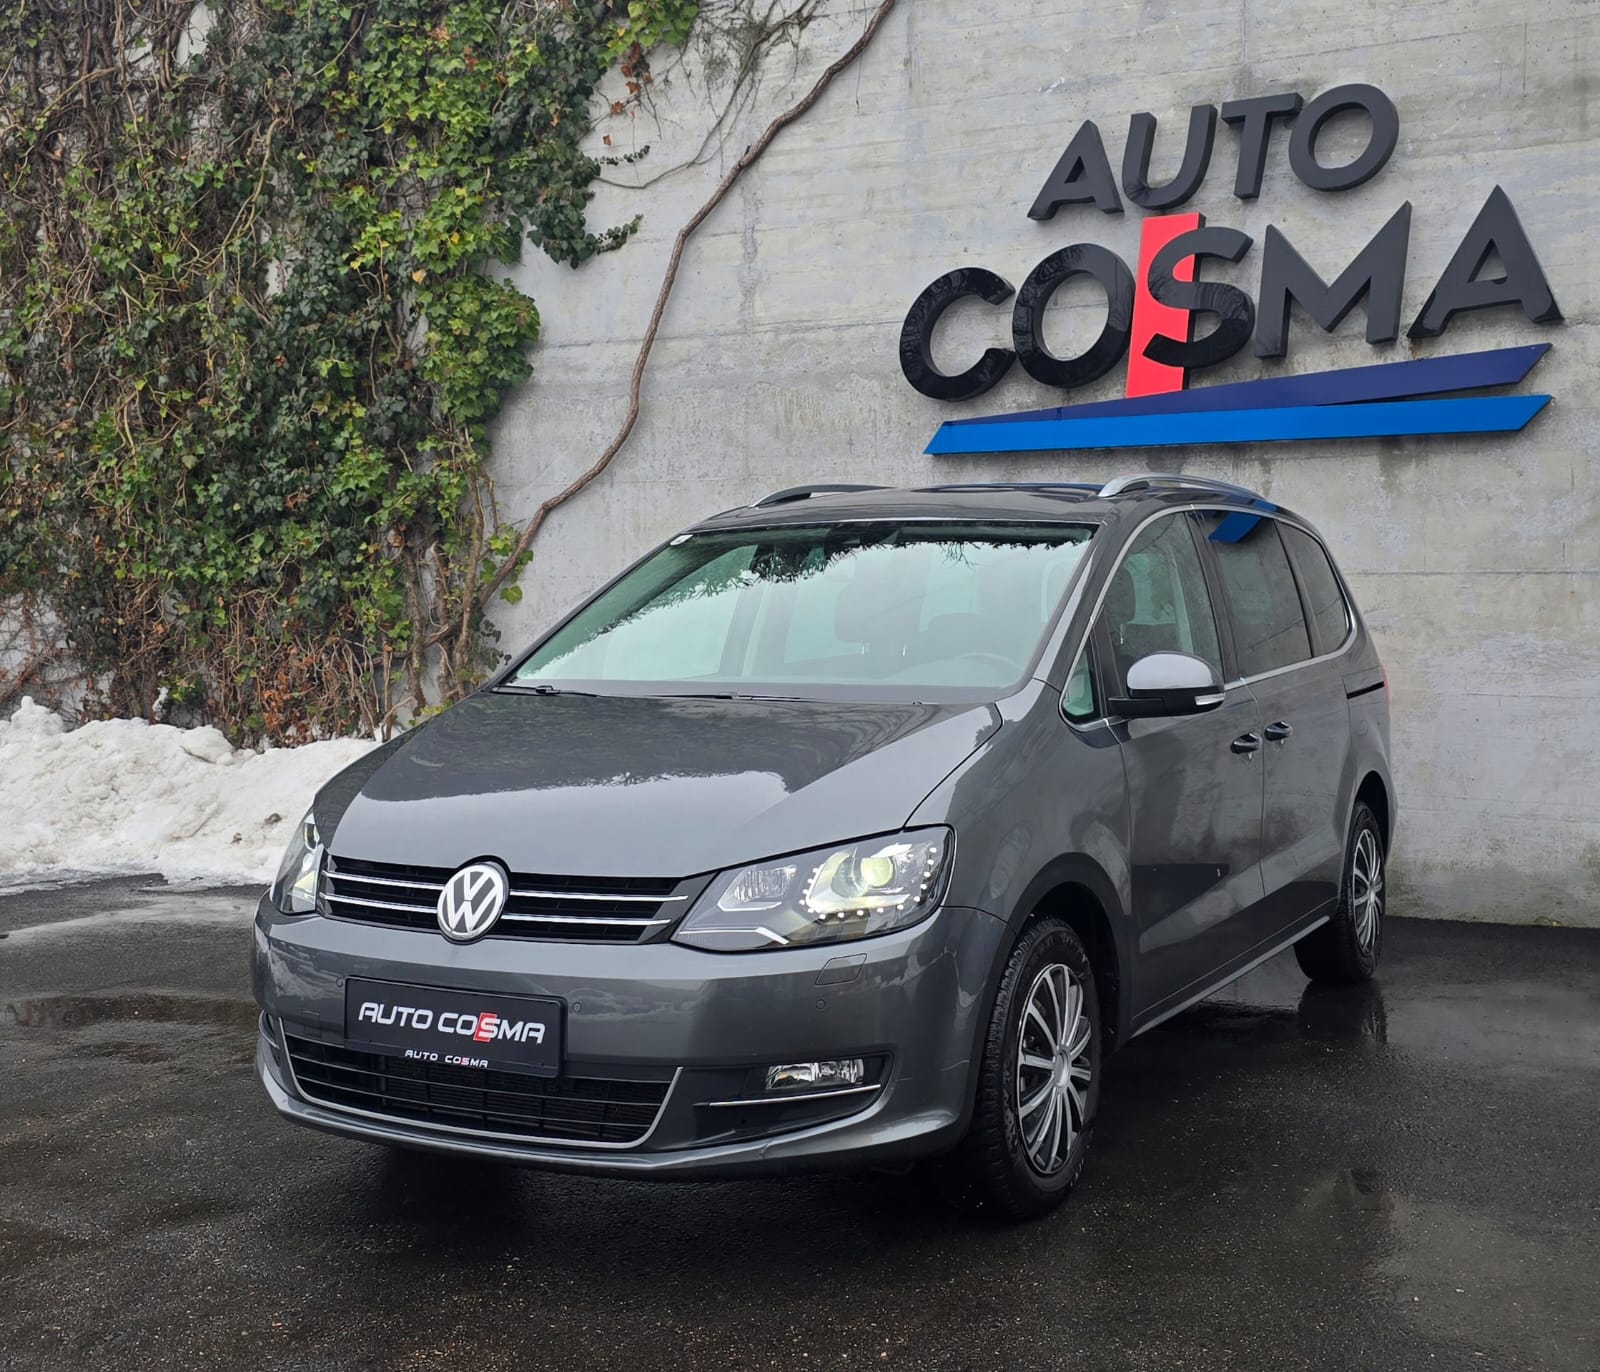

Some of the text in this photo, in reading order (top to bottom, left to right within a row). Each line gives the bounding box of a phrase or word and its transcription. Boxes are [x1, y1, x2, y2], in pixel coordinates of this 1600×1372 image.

[1027, 83, 1399, 221] AUTO
[899, 184, 1563, 402] COSMA
[438, 865, 503, 939] VW
[358, 1002, 545, 1044] AUTO COSMA
[405, 1049, 489, 1069] AUTO COSMA
